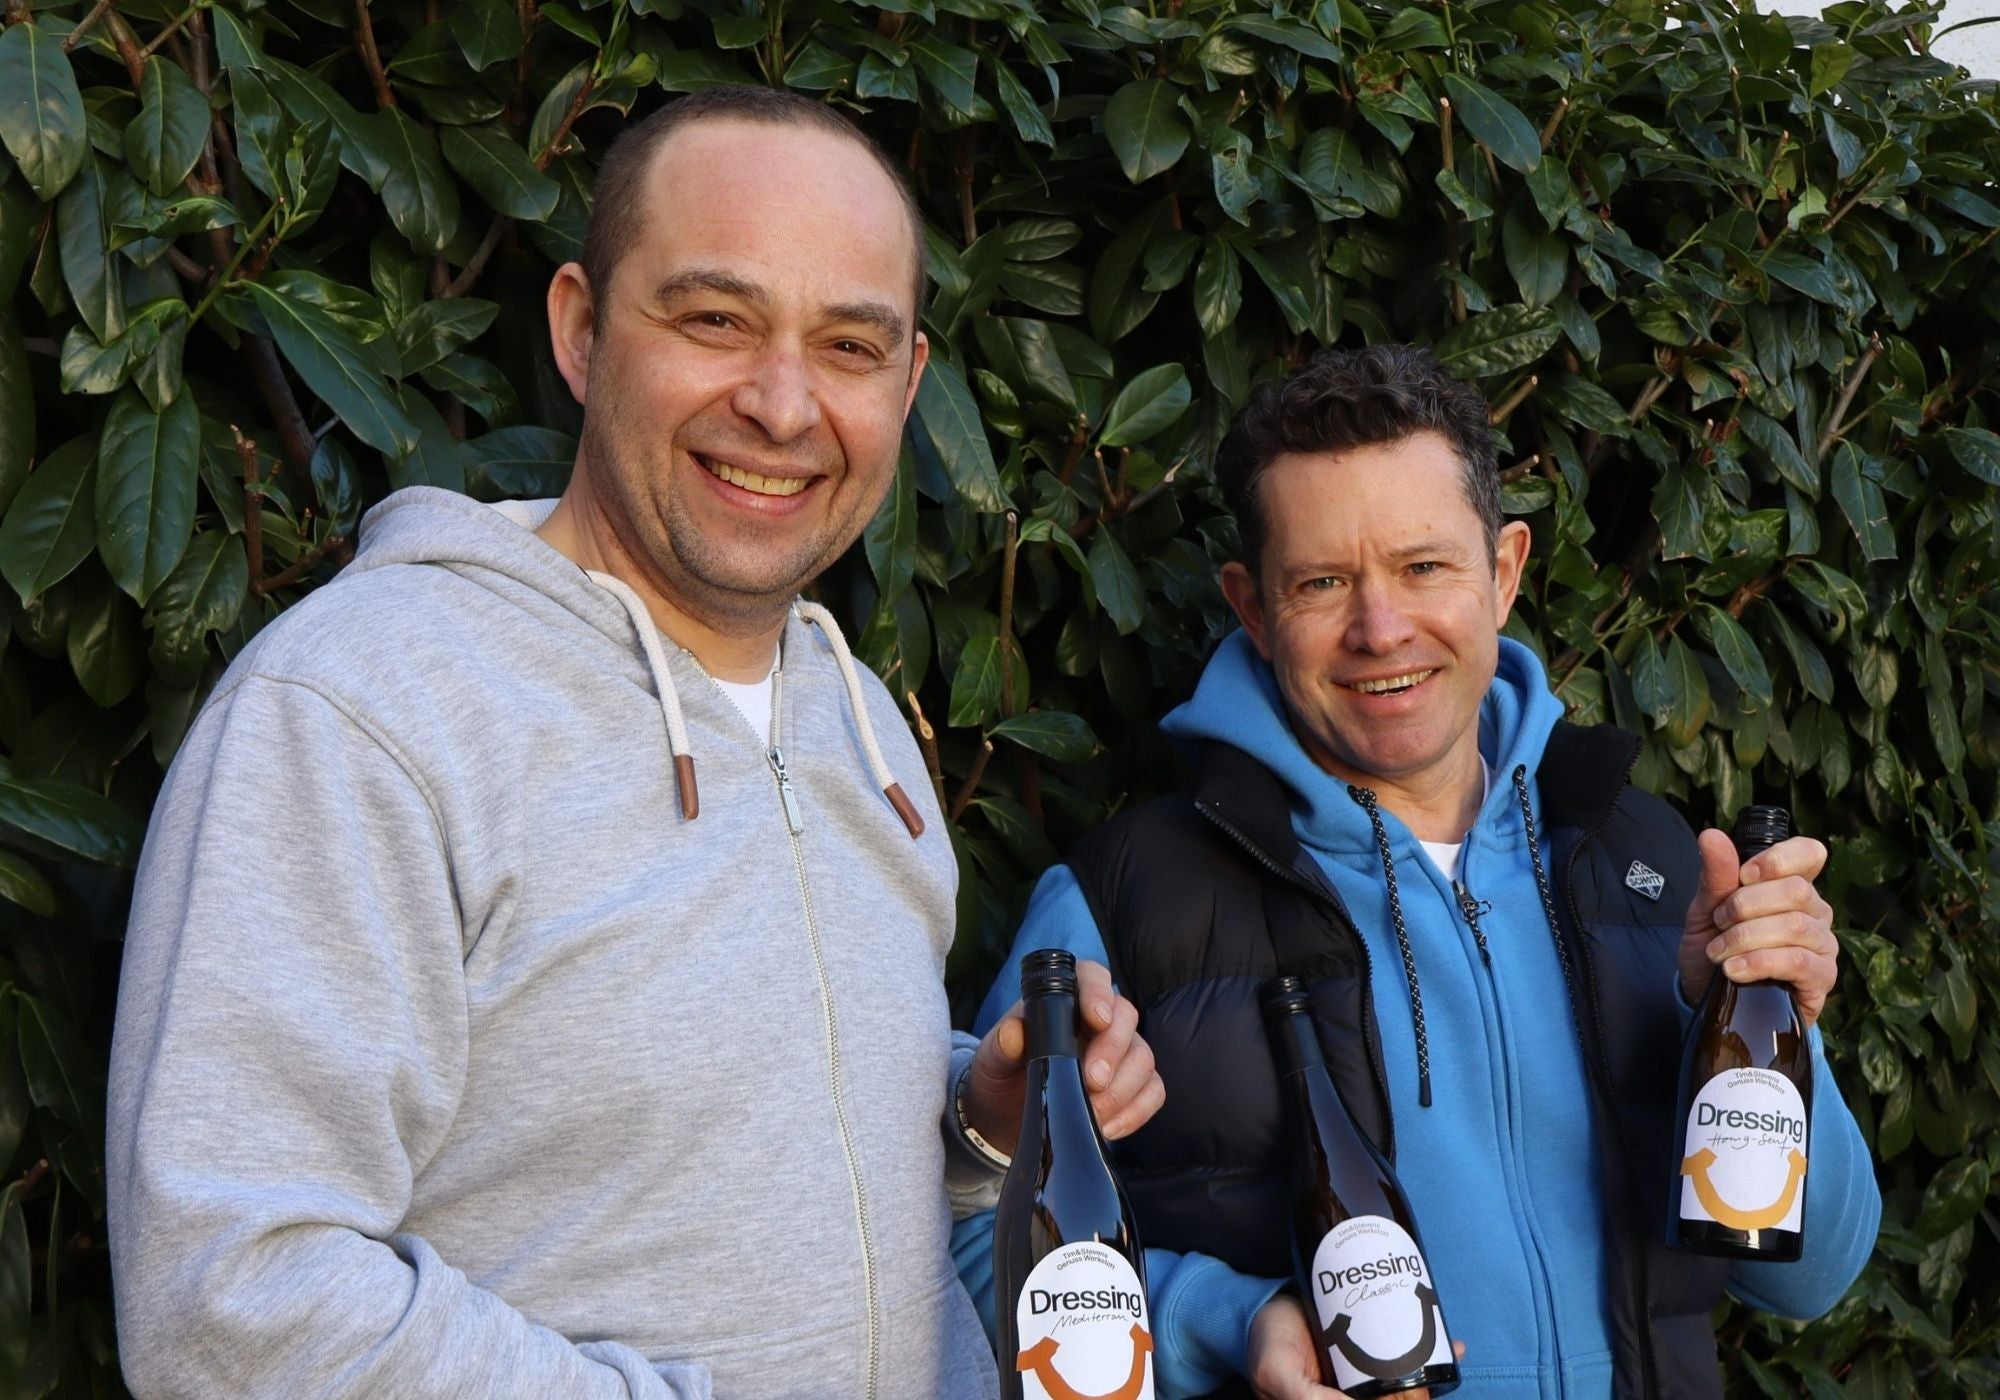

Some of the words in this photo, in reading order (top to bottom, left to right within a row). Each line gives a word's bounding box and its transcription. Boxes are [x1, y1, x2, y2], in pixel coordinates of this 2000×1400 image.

[1697, 1102, 1803, 1143] Dressing
[1318, 1252, 1422, 1295] Dressing
[1030, 1285, 1142, 1318] Dressing
[1344, 1279, 1409, 1308] Classic
